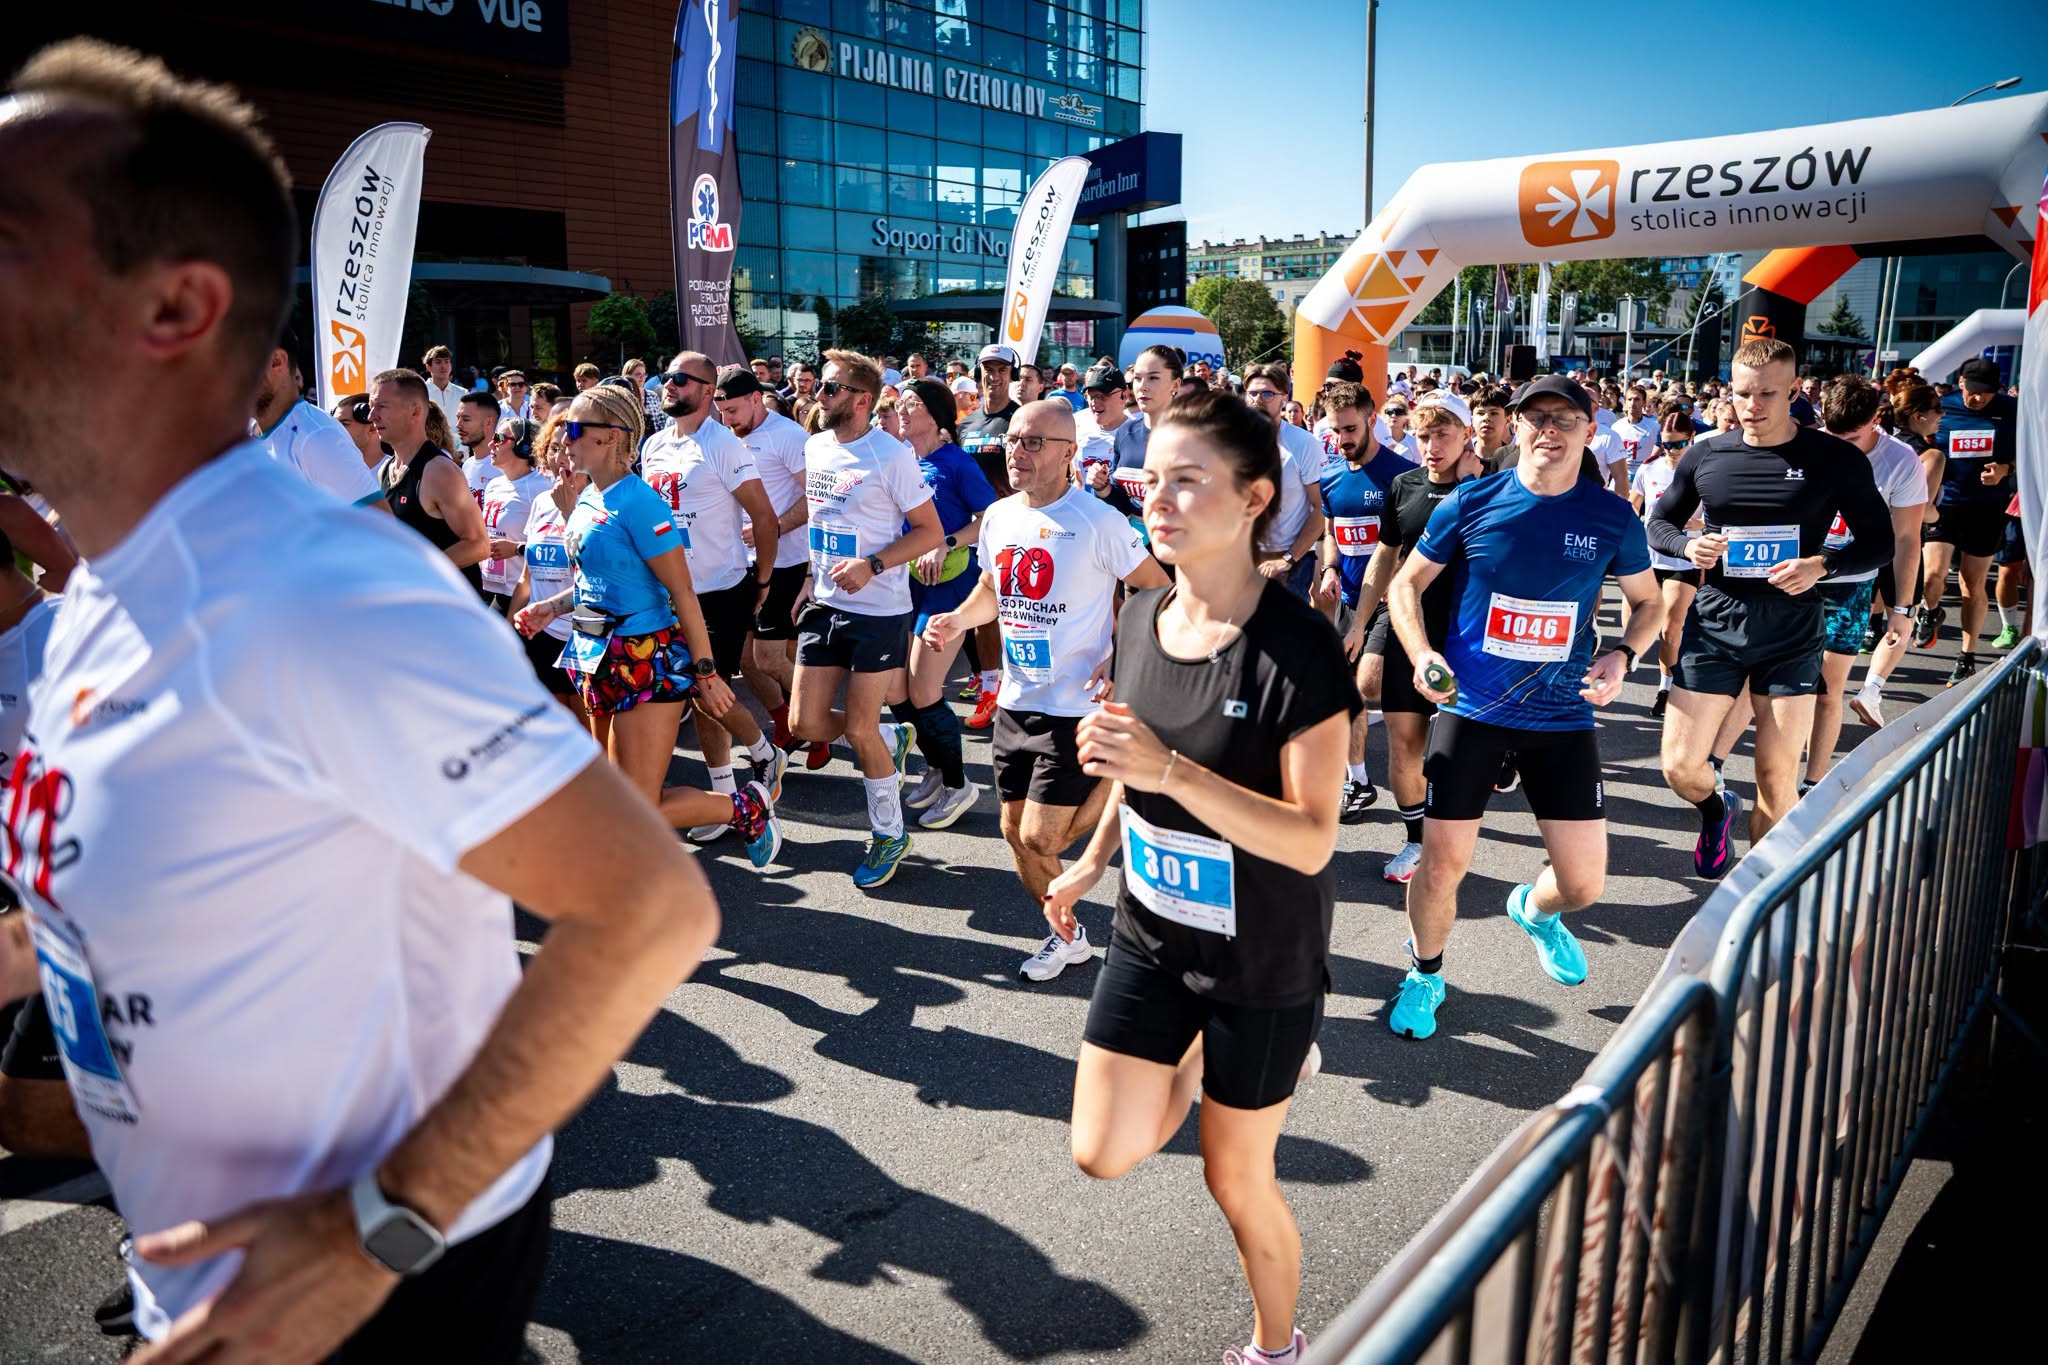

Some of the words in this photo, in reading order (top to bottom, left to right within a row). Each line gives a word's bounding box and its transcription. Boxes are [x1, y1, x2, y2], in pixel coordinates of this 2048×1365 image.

[839, 42, 934, 95] PIJALNIA
[944, 67, 1046, 118] CZEKOLADY
[1118, 173, 1138, 192] Inn
[1630, 146, 1872, 203] rzeszów
[1630, 207, 1717, 231] stolica
[1729, 192, 1866, 224] innowacji
[336, 164, 381, 317] rzeszów
[689, 222, 730, 249] PCRM
[873, 218, 945, 255] Sapori
[951, 227, 972, 253] di
[978, 231, 1010, 258] Na
[356, 264, 374, 321] stolica
[366, 176, 394, 258] innowacji
[1958, 438, 1986, 449] 1354
[808, 470, 838, 484] ESTIWAL
[808, 480, 835, 491] EGOWY
[818, 491, 847, 503] Whitney
[1364, 490, 1384, 500] EME
[1830, 516, 1842, 530] 0
[1344, 527, 1368, 541] 816
[1564, 533, 1598, 550] EME
[535, 546, 557, 562] 612
[1563, 546, 1597, 561] AERO
[1744, 543, 1781, 561] 207
[1018, 601, 1067, 613] PUCHAR
[1019, 612, 1059, 626] Whitney
[1501, 613, 1559, 640] 1046
[1010, 643, 1037, 661] 253
[1143, 846, 1200, 891] 301
